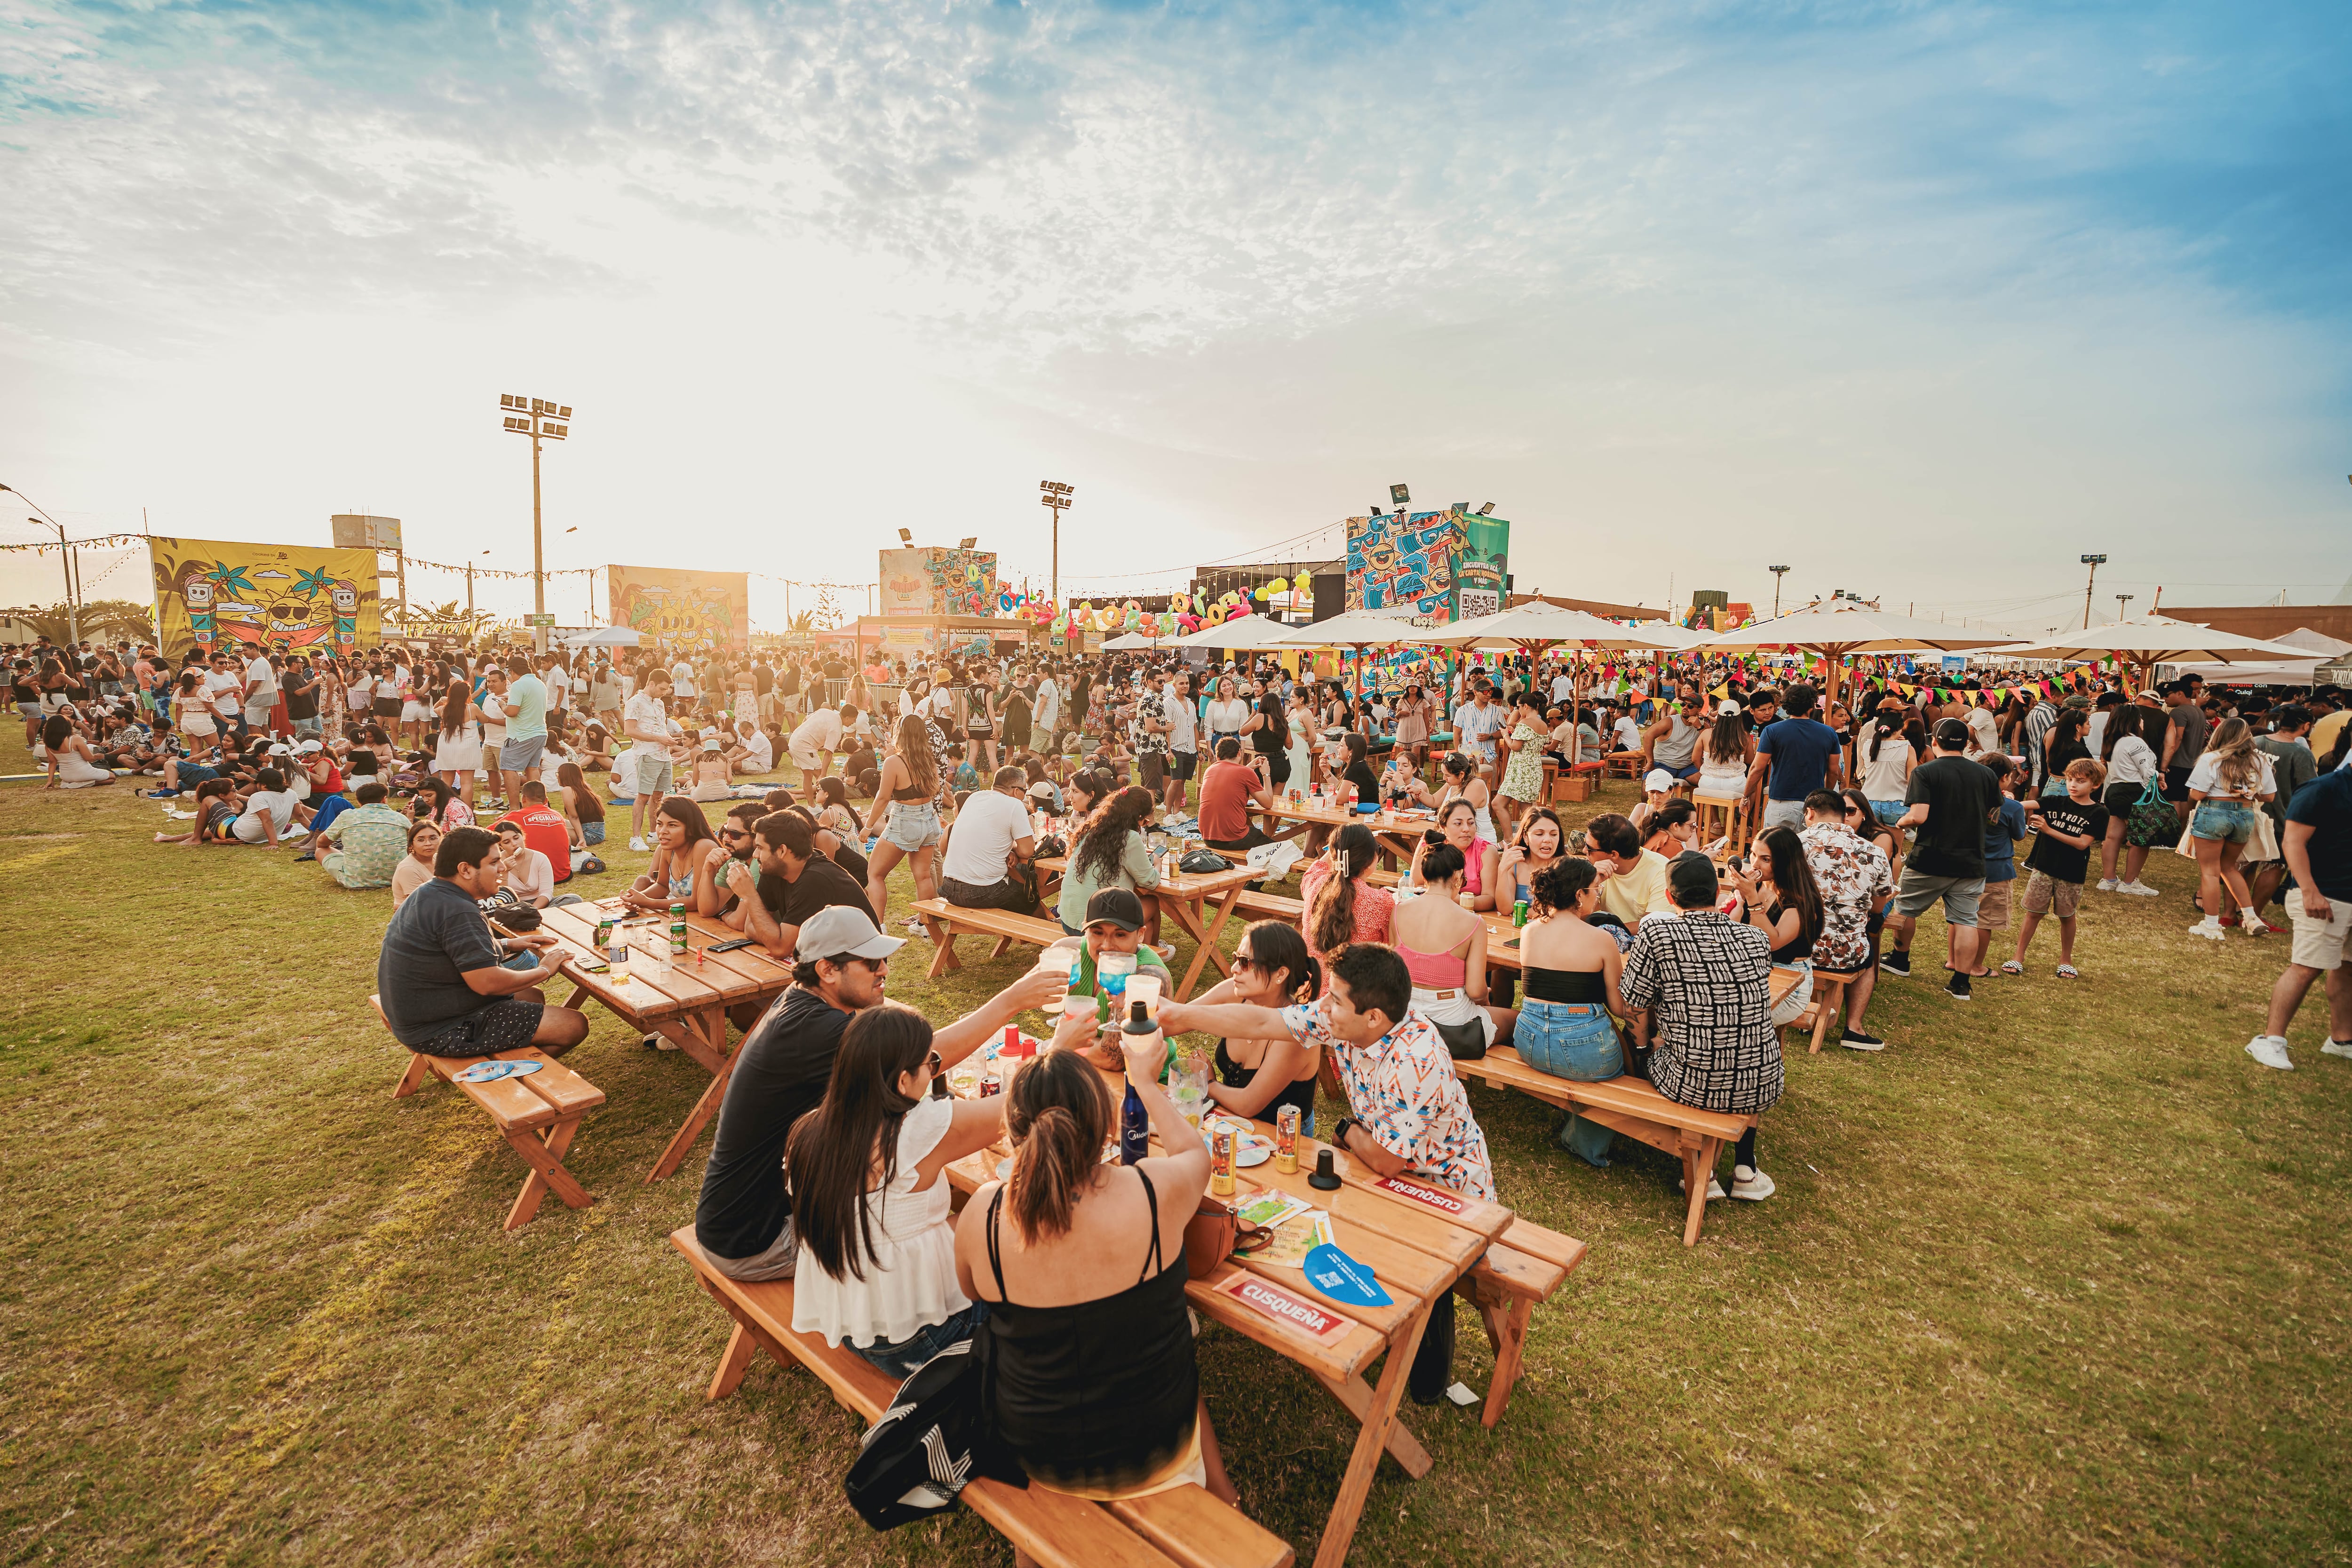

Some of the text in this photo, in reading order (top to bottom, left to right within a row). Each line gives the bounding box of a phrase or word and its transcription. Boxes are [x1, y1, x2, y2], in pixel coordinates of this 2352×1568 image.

[1489, 564, 1498, 573] ACÁ
[1481, 570, 1502, 581] HORARIOS
[1412, 617, 1435, 627] NOS
[2051, 820, 2066, 828] AND
[2060, 812, 2090, 827] PROTE
[1388, 1179, 1462, 1211] CUSQUEÑA
[1242, 1284, 1327, 1331] CUSQUEÑA
